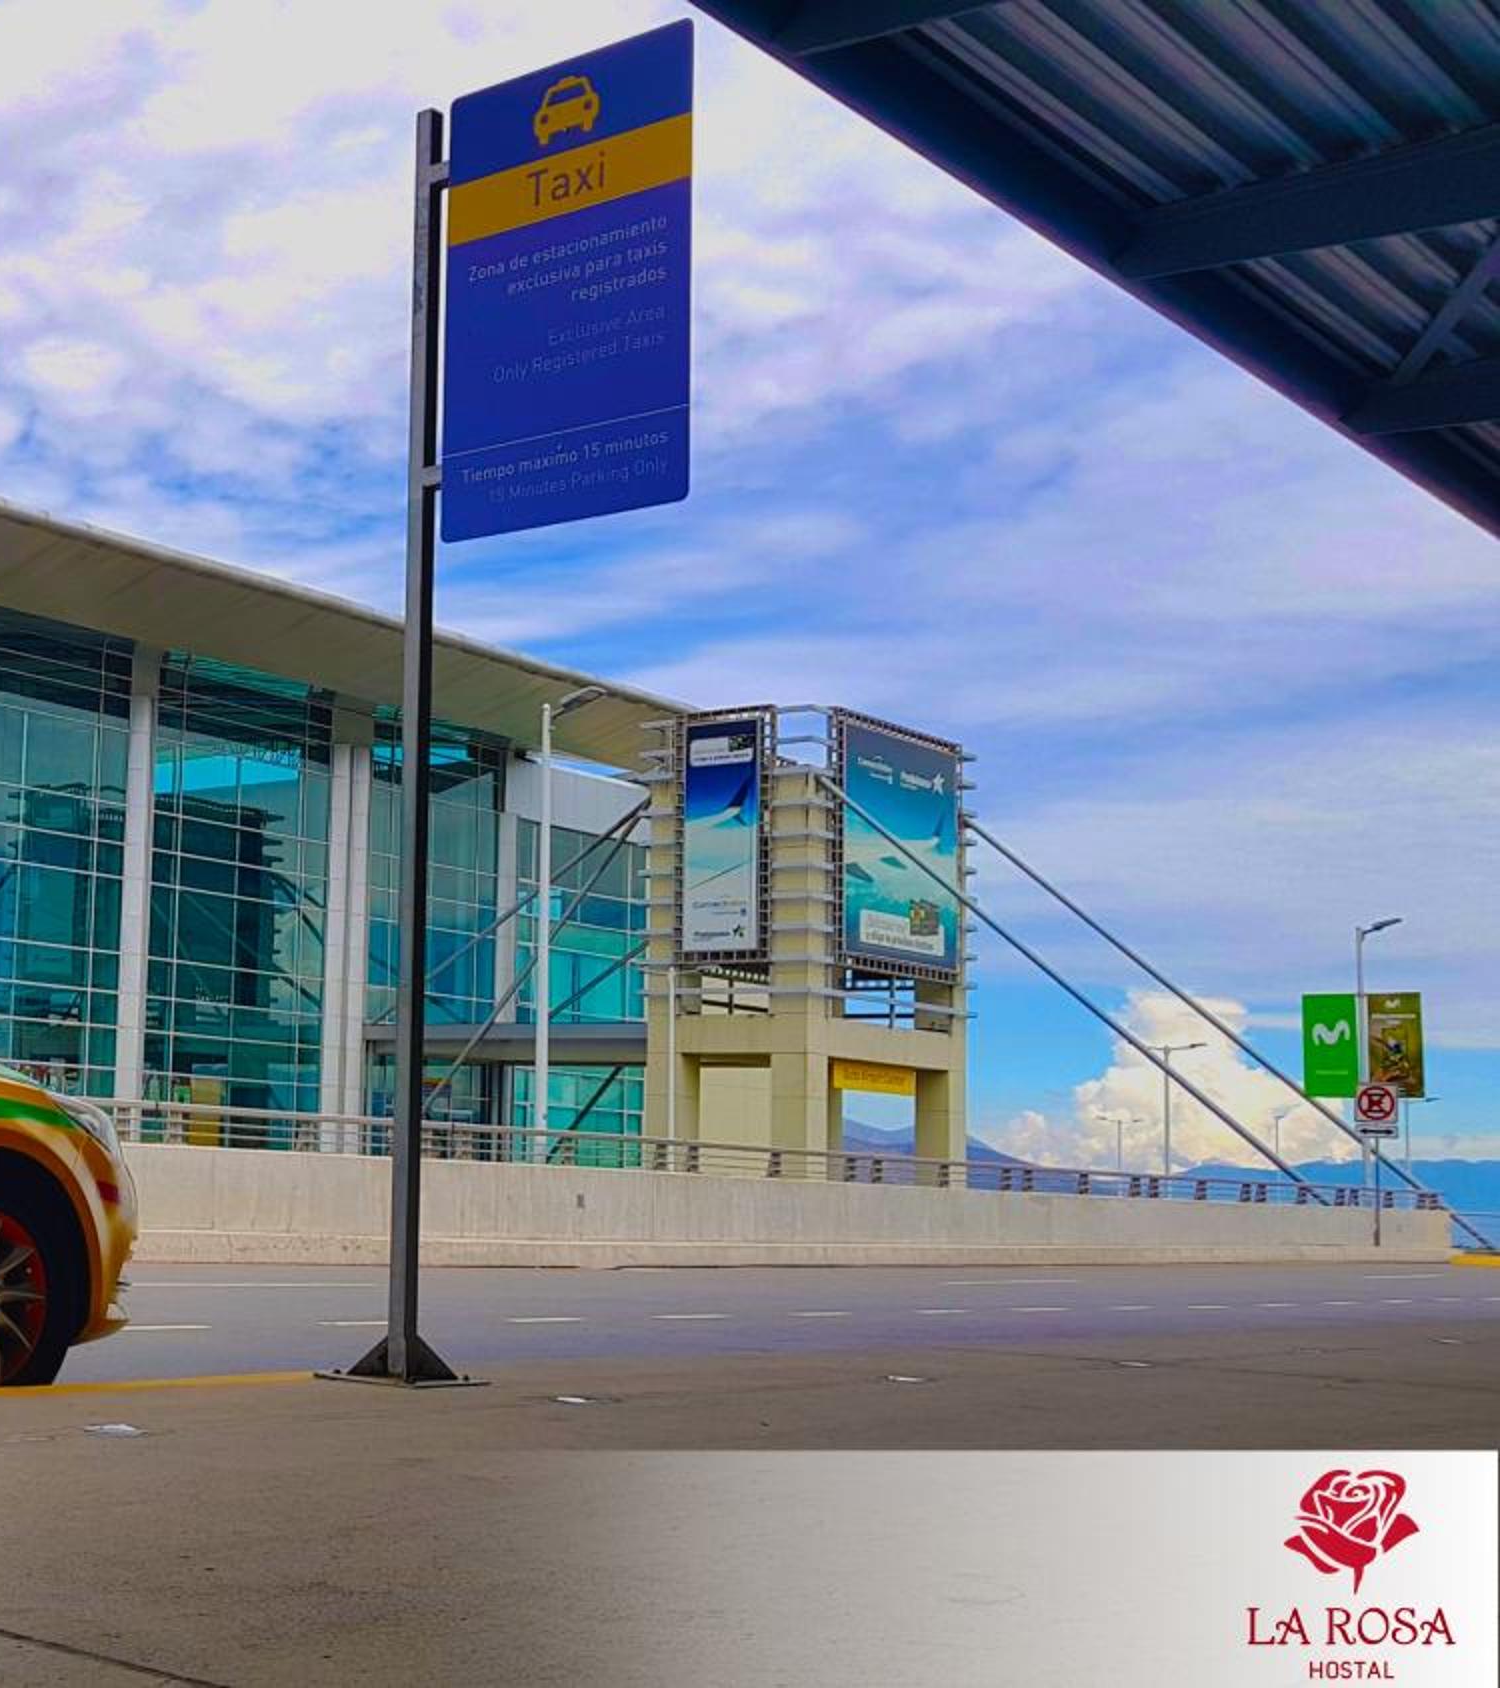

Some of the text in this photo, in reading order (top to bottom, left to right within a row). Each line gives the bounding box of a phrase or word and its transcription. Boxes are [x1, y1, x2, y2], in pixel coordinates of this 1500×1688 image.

[527, 151, 606, 207] Taxi
[468, 215, 668, 282] Zona de estacionamiento
[506, 240, 668, 296] exclusiva para taxis
[570, 265, 668, 301] registrados
[490, 361, 528, 384] Only
[460, 463, 515, 483] Tiempo
[582, 442, 601, 460] 15
[605, 431, 669, 456] minutos
[635, 456, 668, 476] Only
